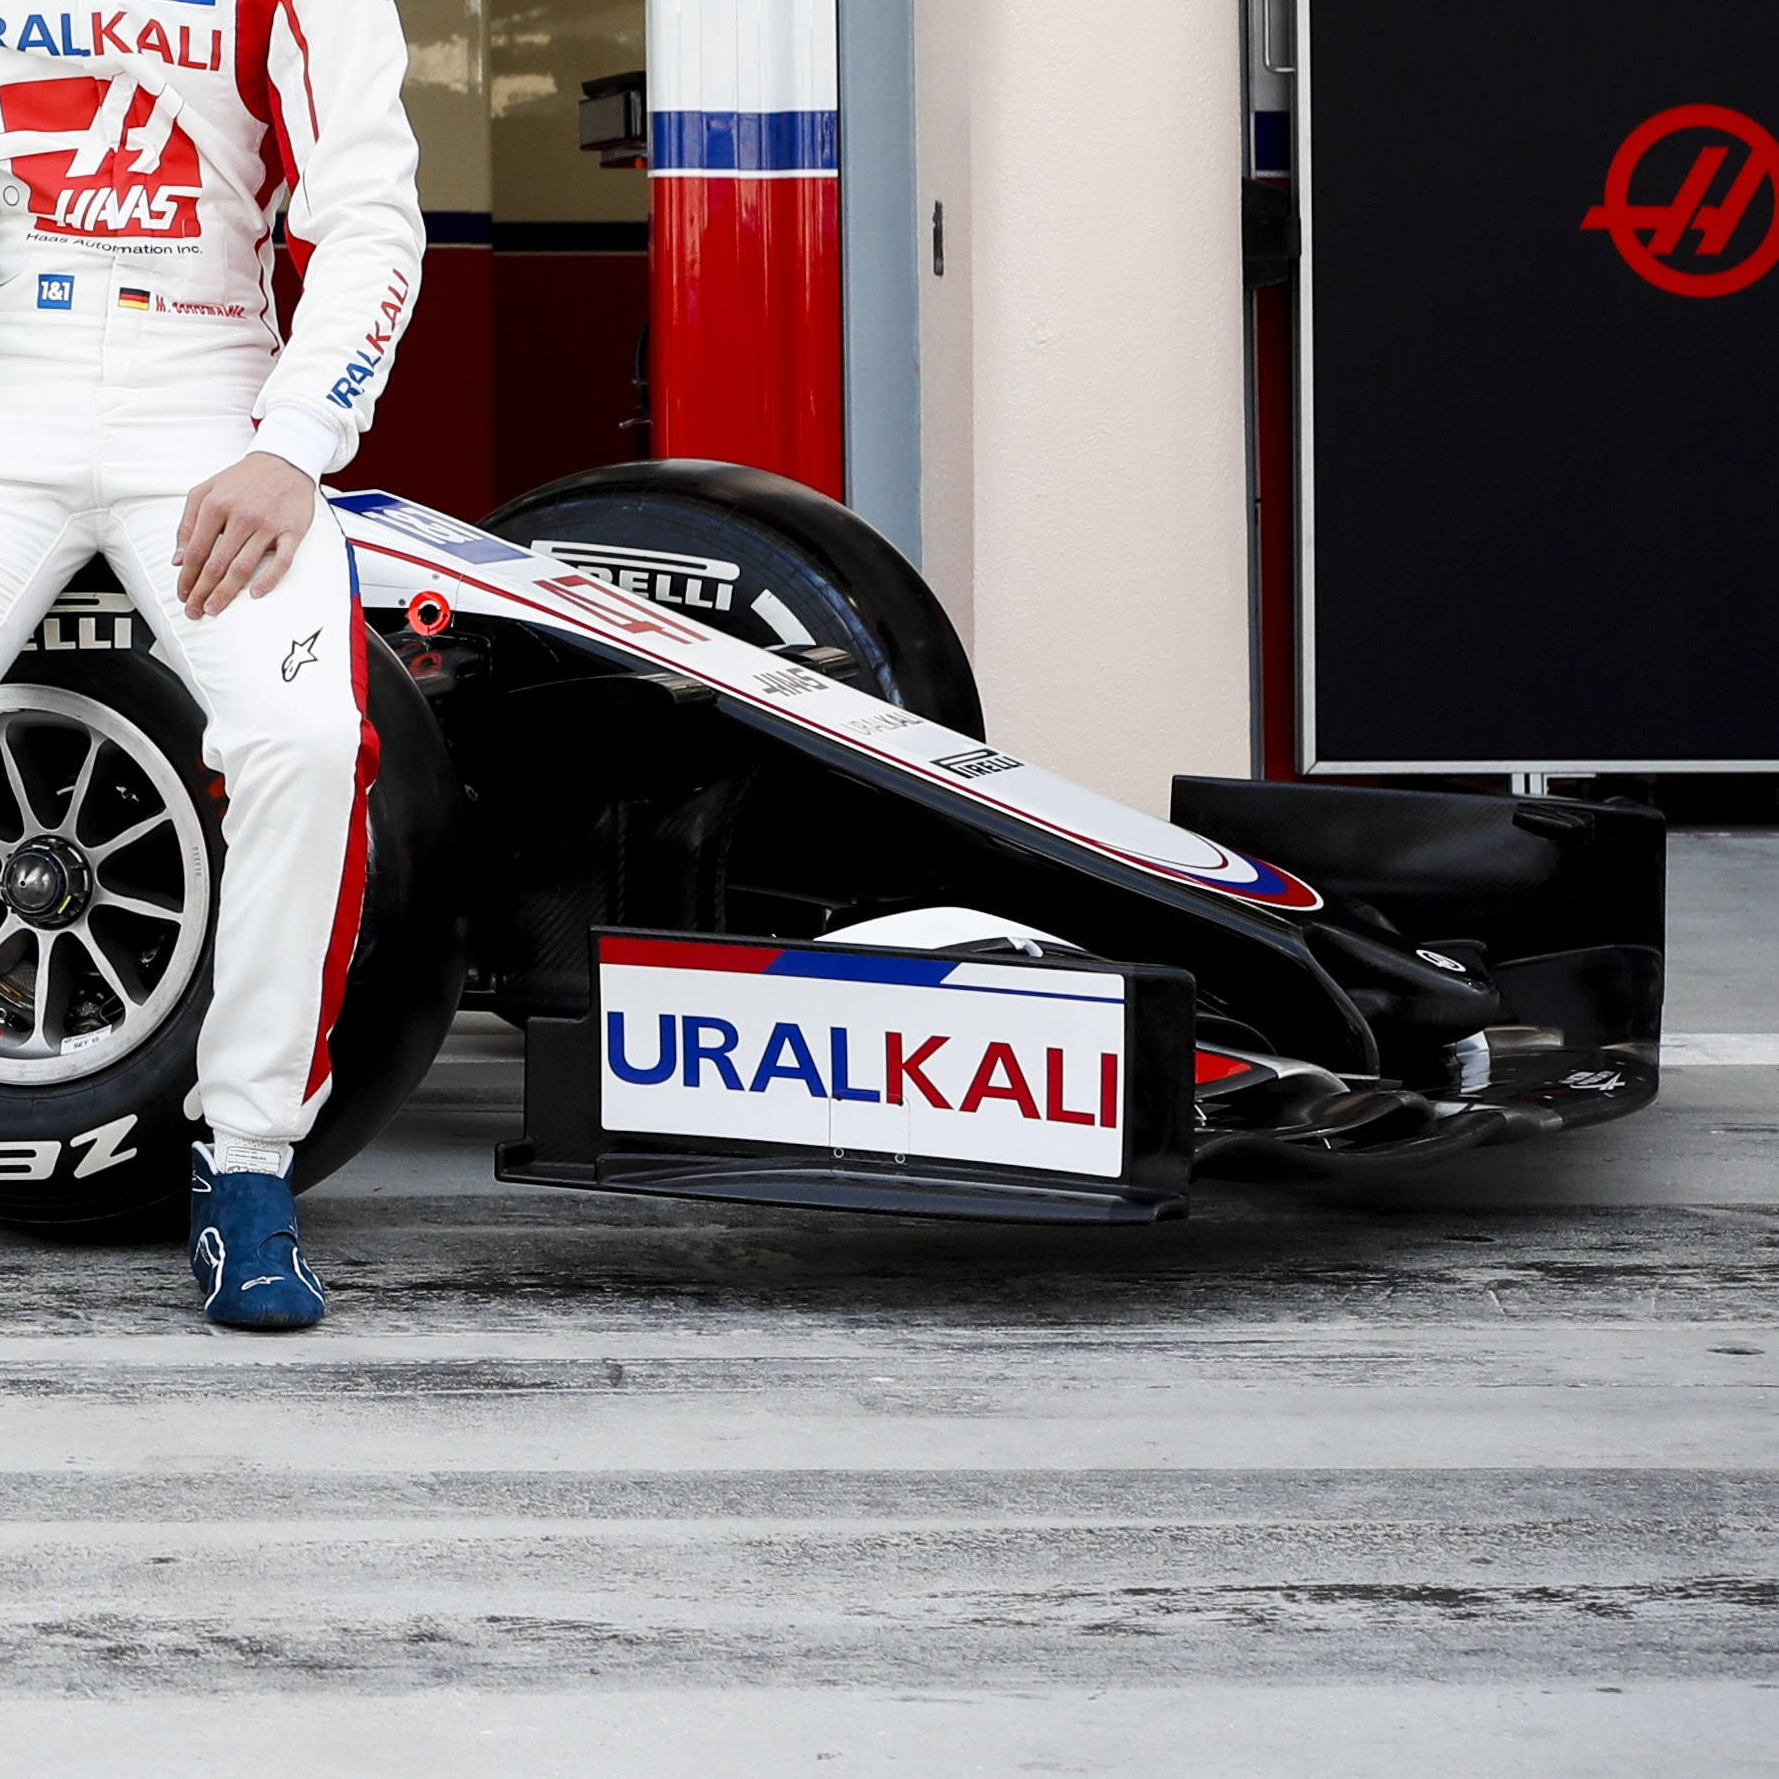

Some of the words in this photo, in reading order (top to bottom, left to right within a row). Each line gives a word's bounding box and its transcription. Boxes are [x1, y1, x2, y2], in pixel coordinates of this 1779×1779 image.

[28, 185, 203, 232] HAAS
[26, 232, 69, 244] Haas
[73, 236, 174, 255] Automation
[177, 244, 204, 255] Inc.
[40, 280, 70, 301] 1&1
[929, 748, 1026, 779] PIRELLI
[605, 1010, 1117, 1129] URALKALI
